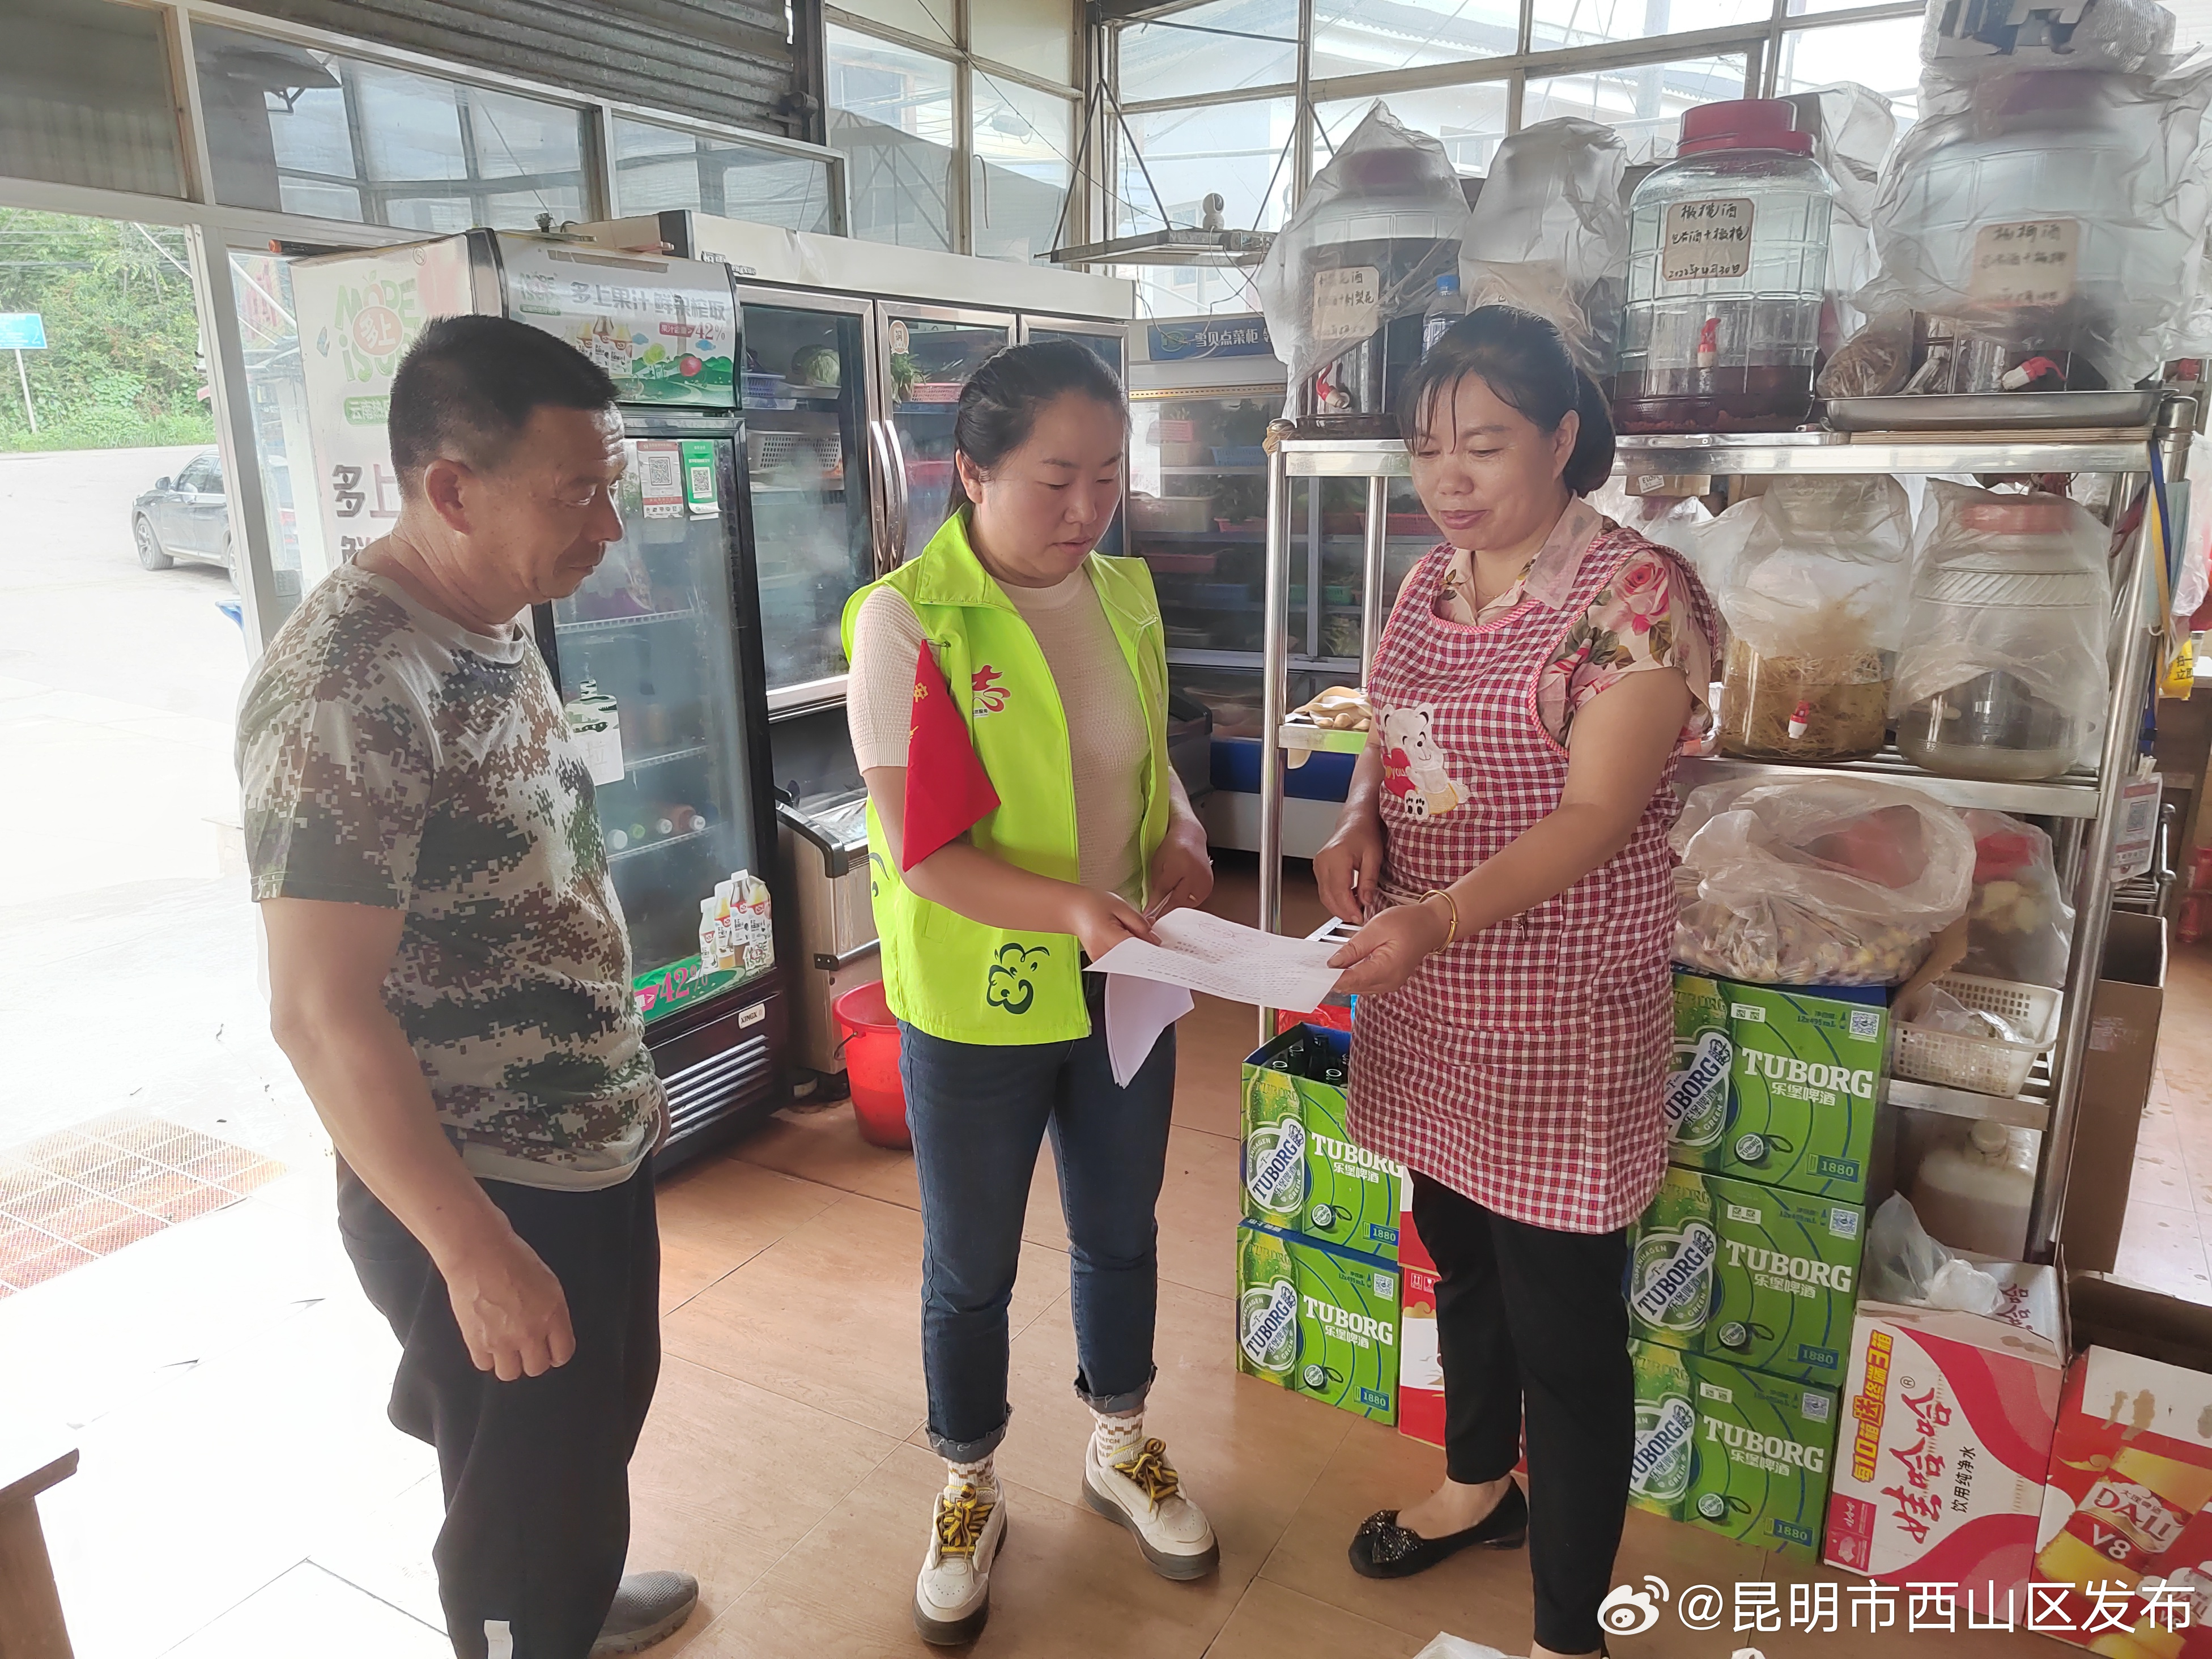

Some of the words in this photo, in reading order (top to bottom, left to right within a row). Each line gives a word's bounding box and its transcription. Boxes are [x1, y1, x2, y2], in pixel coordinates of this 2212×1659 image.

[571, 281, 649, 311] 多上果汁
[661, 324, 687, 334] 果汁含
[695, 322, 725, 341] 42%
[660, 964, 708, 1004] 42%
[1742, 1047, 1873, 1099] TUBORG
[1664, 1057, 1721, 1125] UBORG
[1771, 1082, 1836, 1107] 乐堡啤酒
[1704, 1105, 1723, 1131] GREEN
[1740, 1138, 1760, 1156] TUBORG
[1252, 1138, 1298, 1200] TUBORG
[1333, 1162, 1380, 1184] 乐堡啤酒
[1820, 1161, 1854, 1177] 1880
[1289, 1179, 1301, 1201] GREEN
[1373, 1228, 1396, 1241] 1880
[1725, 1239, 1852, 1292] TUBORG
[1637, 1247, 1705, 1316] TUBORG
[1754, 1273, 1817, 1299] 乐堡啤酒
[1246, 1299, 1291, 1357] TUBORG
[1303, 1294, 1393, 1346] TUBORG
[1281, 1338, 1294, 1360] GREEN
[1324, 1325, 1369, 1349] 乐堡啤酒
[1802, 1349, 1834, 1364] 1880
[1363, 1391, 1386, 1407] 1880
[1852, 1330, 1894, 1483] 每10箱送终端3箱
[1703, 1415, 1824, 1473] TUBORG
[1730, 1449, 1790, 1477] 乐堡啤酒
[1881, 1387, 1952, 1544] 娃哈哈
[1951, 1445, 1976, 1513] 饮用纯净水
[2094, 1487, 2171, 1542] DALI
[1778, 1524, 1807, 1541] 1880
[2093, 1524, 2131, 1560] V8
